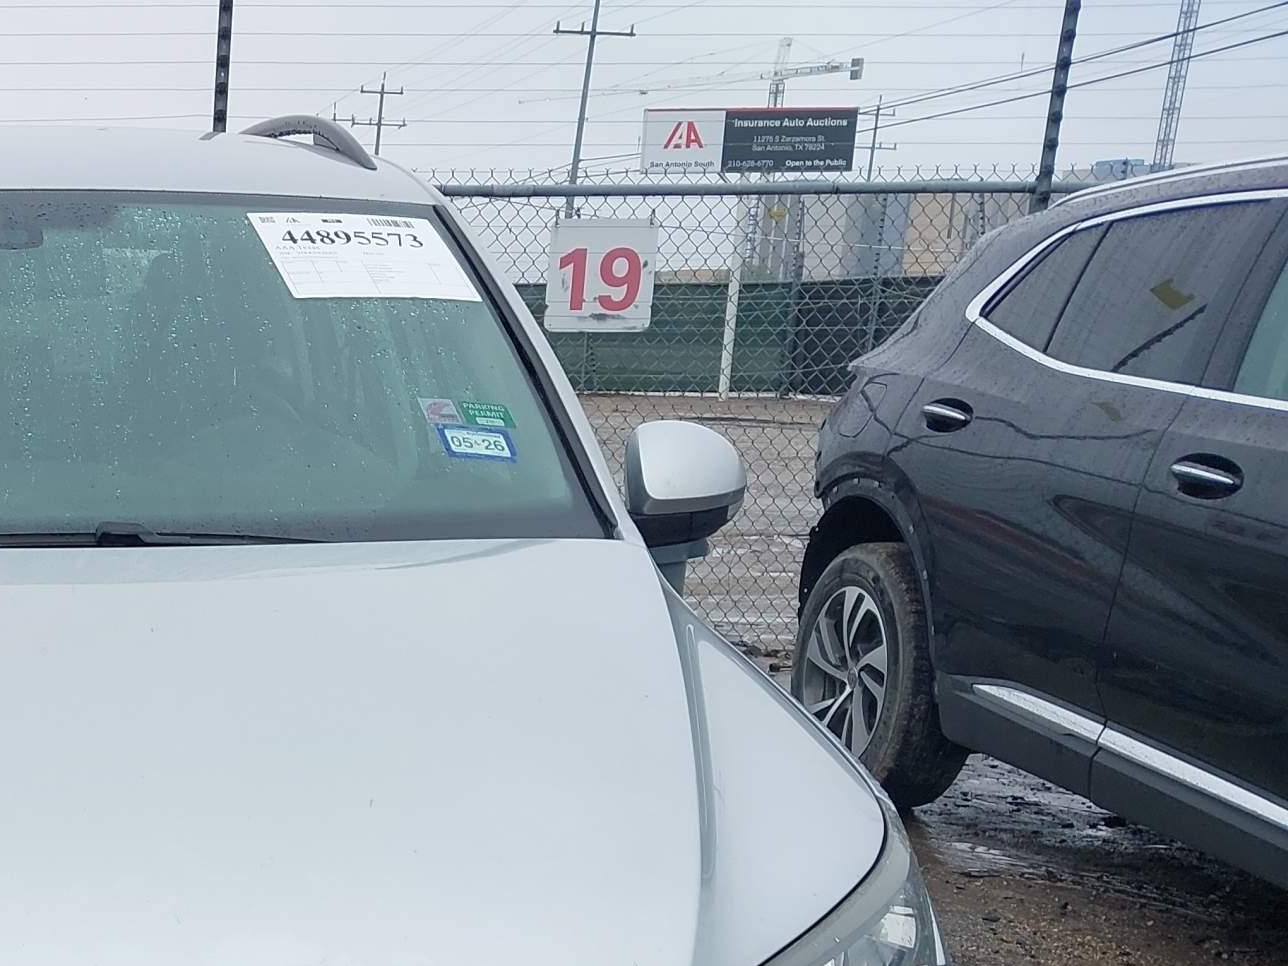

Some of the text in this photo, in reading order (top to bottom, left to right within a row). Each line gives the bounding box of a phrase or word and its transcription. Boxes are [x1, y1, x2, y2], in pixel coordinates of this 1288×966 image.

[734, 117, 848, 127] Insurance Auto Auctions
[785, 160, 803, 168] Open
[282, 230, 424, 249] 44895573
[559, 247, 642, 311] 19
[463, 403, 505, 411] PARKING
[469, 410, 504, 418] PERMIT
